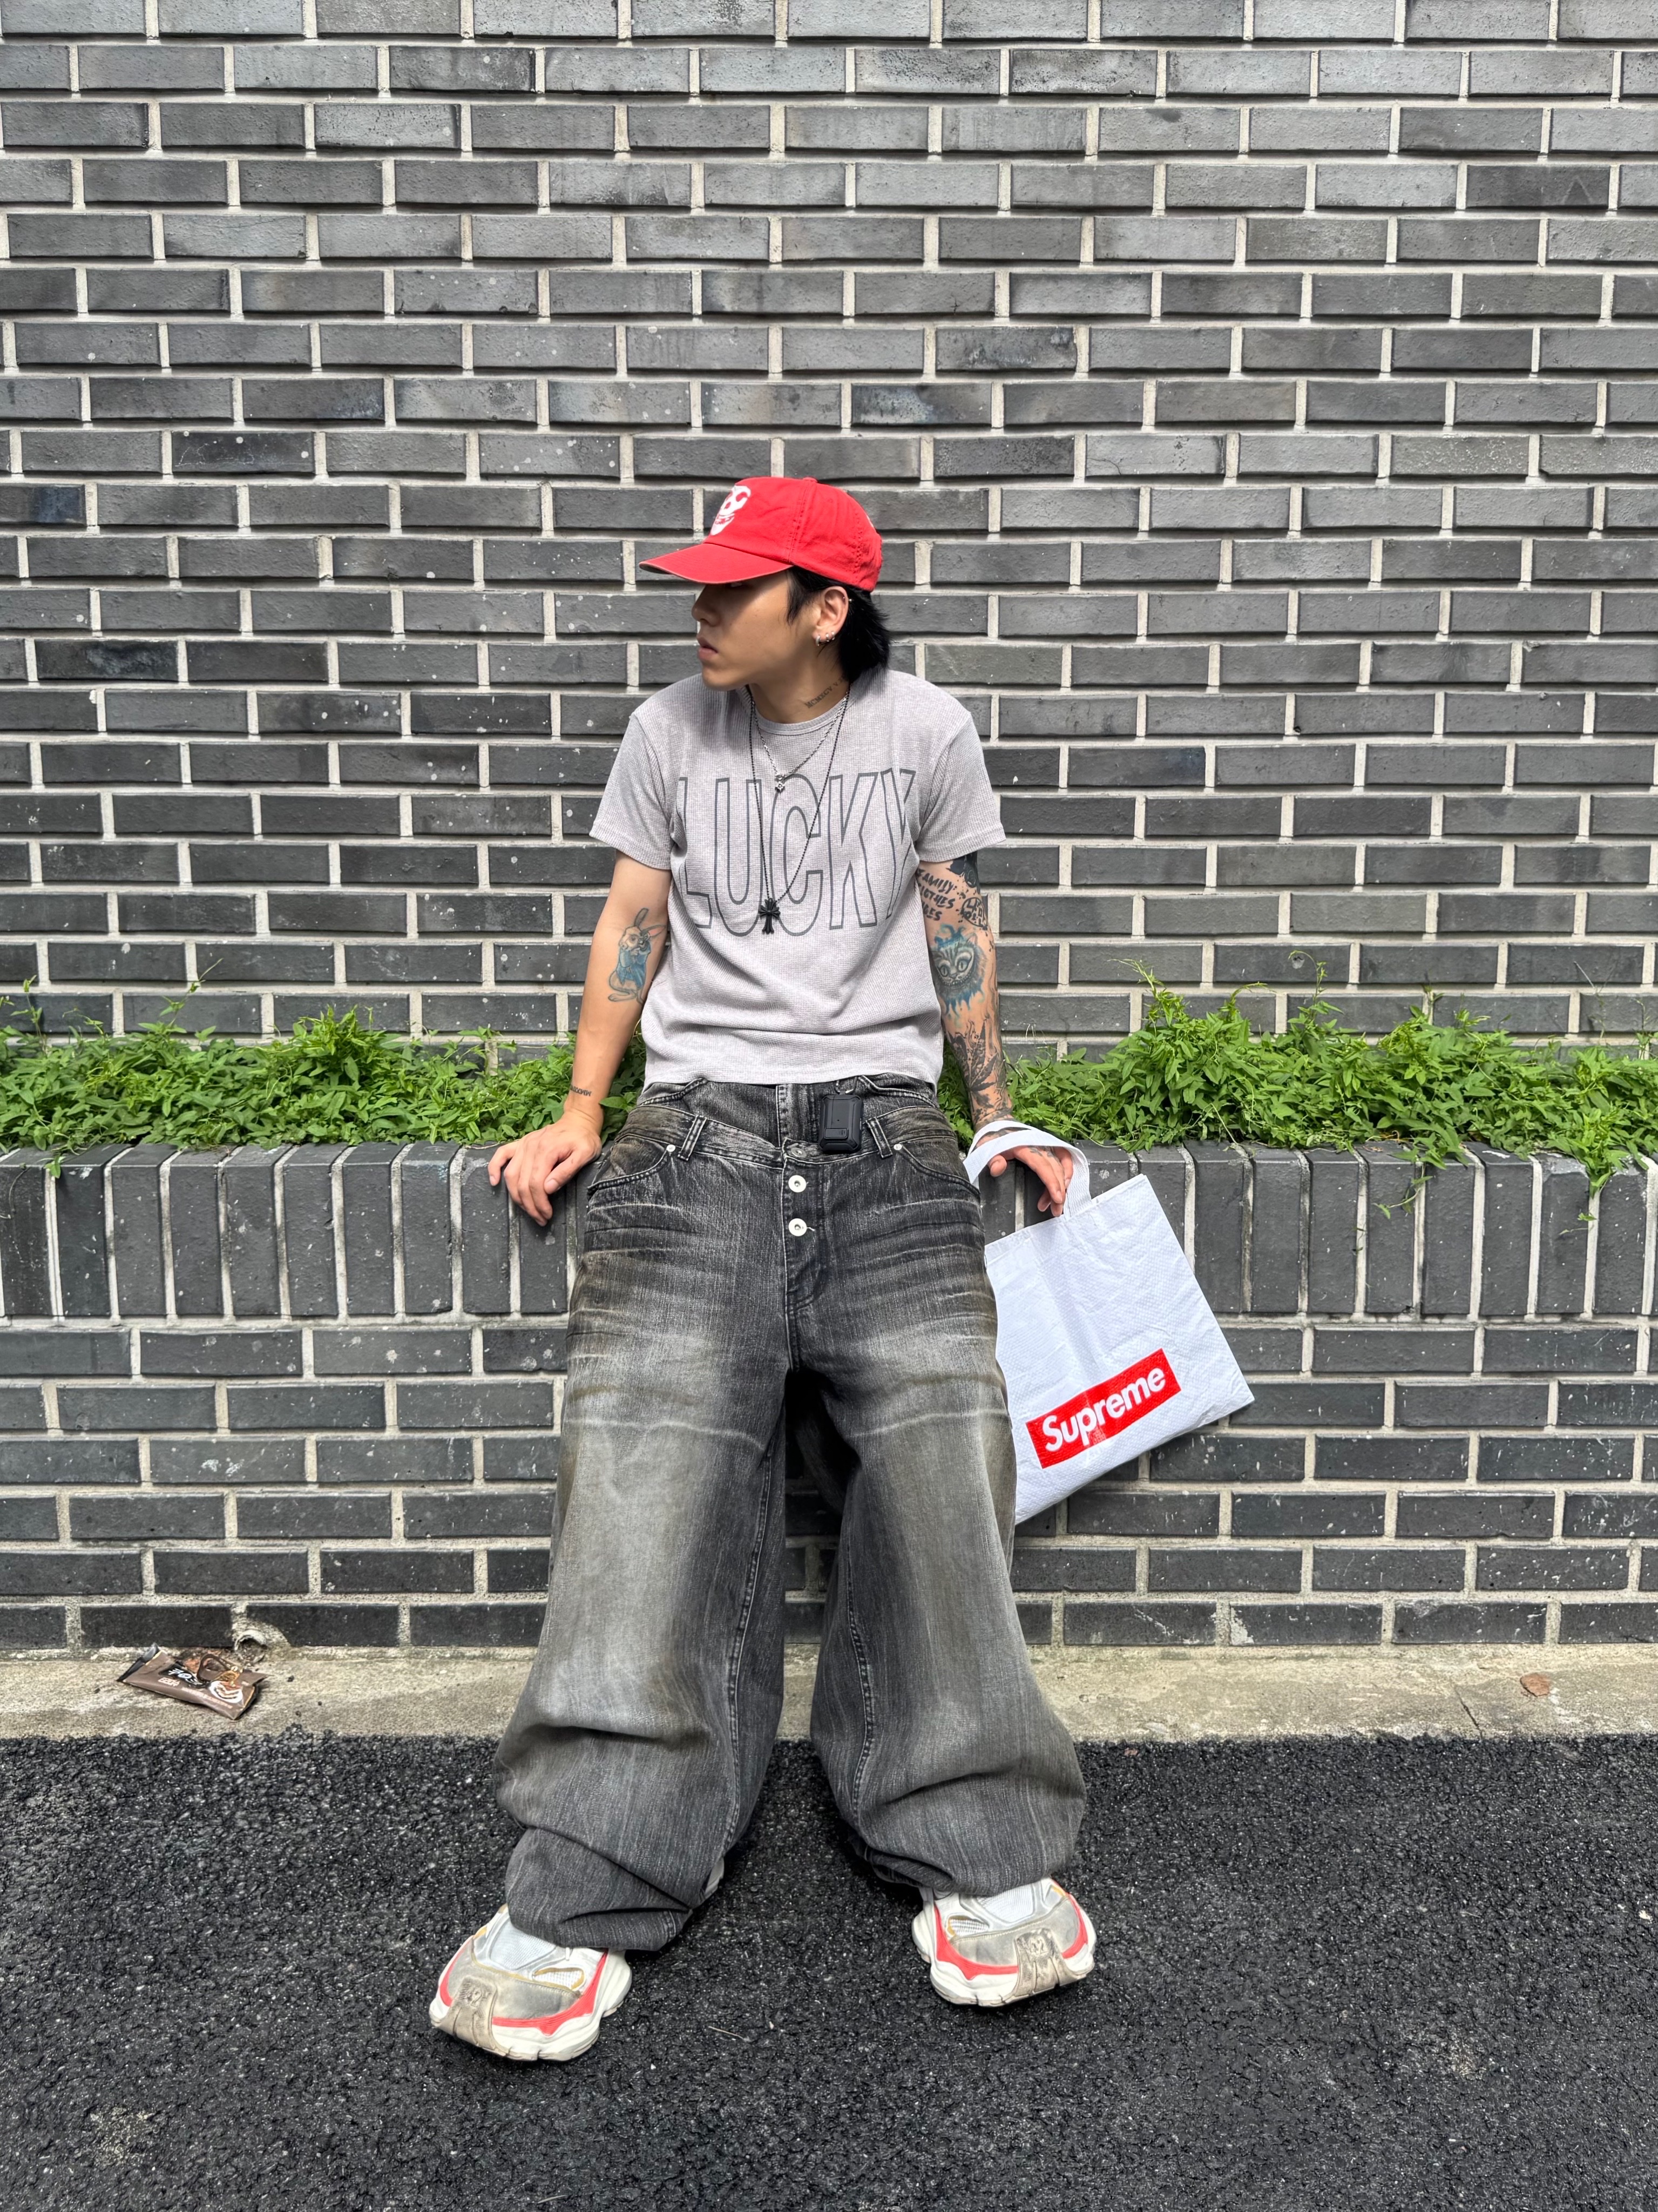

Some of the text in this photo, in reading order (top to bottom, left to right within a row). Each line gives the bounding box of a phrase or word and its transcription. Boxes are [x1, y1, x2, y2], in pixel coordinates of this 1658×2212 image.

[675, 767, 917, 937] LUCKY
[918, 882, 956, 909] LOTHES
[1041, 1367, 1166, 1452] Supreme
